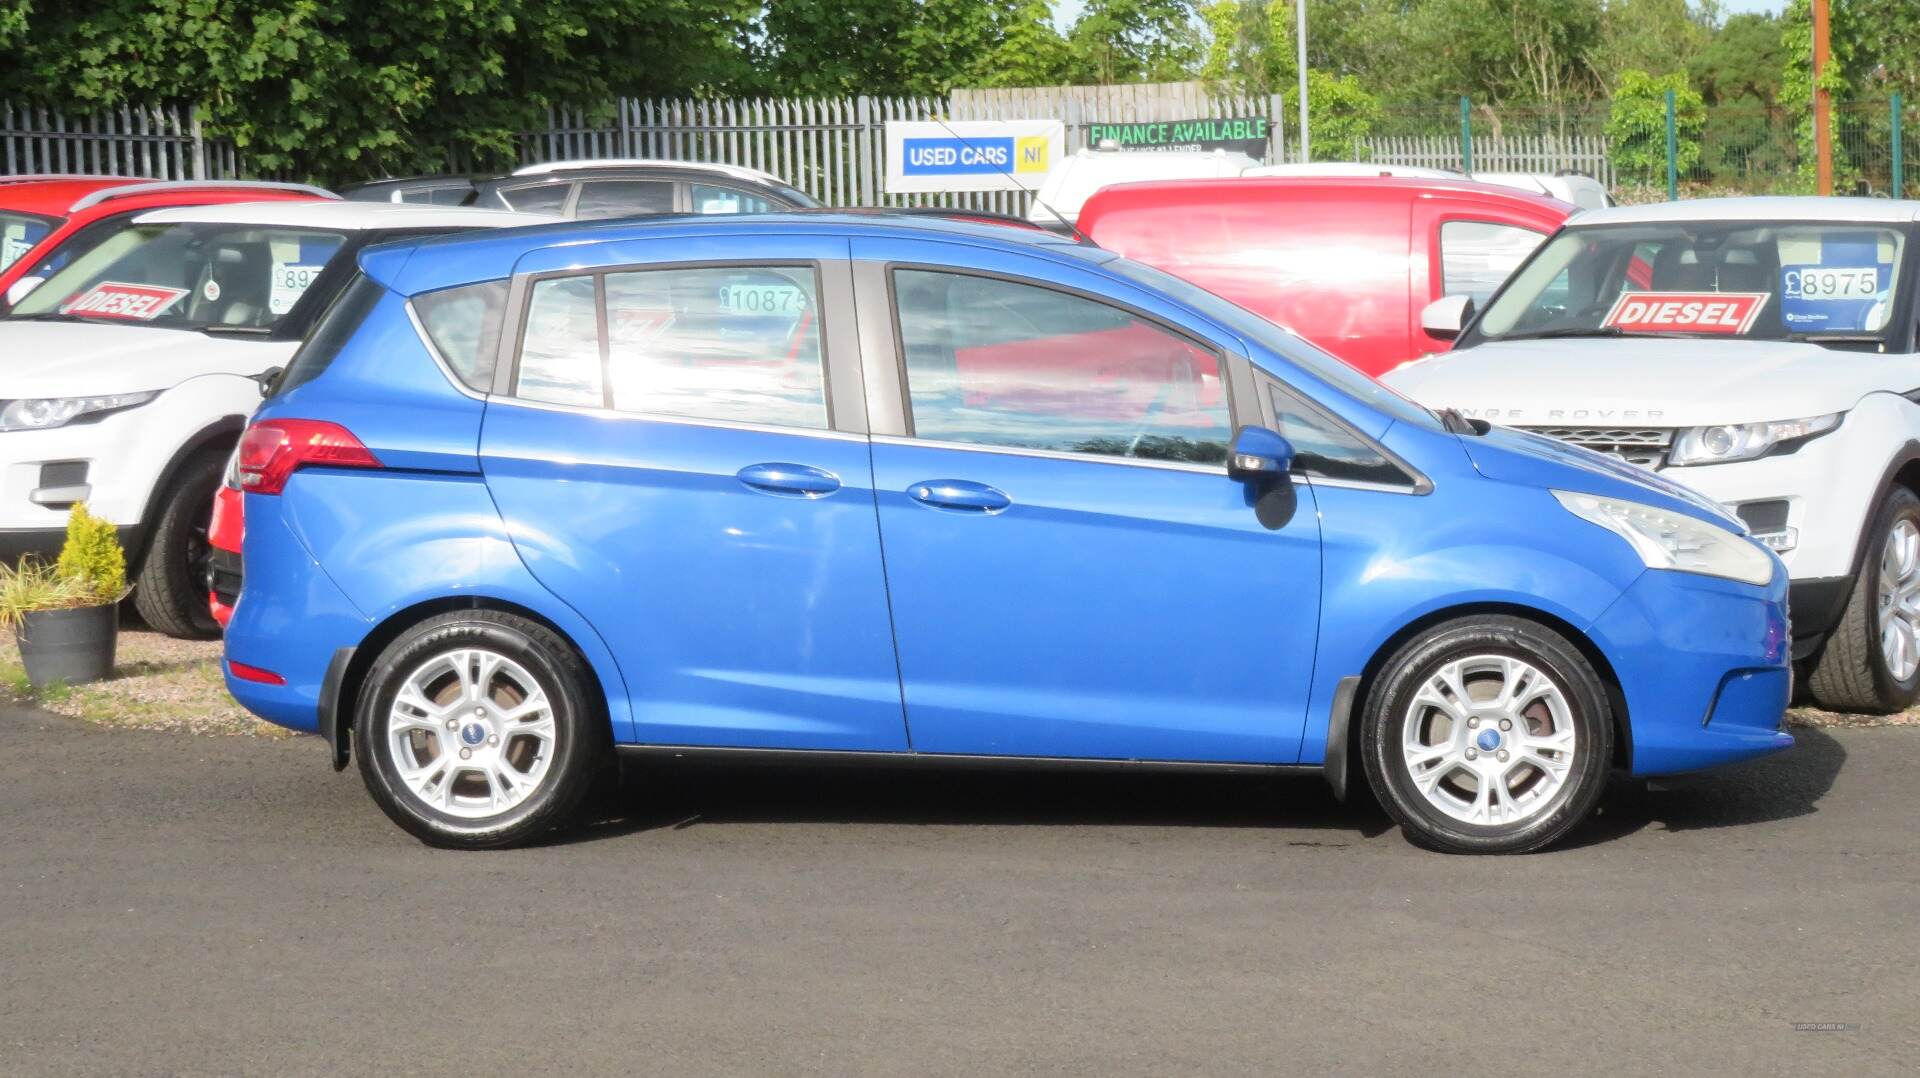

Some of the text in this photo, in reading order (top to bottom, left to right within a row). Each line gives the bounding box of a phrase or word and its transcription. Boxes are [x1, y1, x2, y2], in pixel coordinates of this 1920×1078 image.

[1091, 119, 1266, 145] FINANCE AVAILABLE
[910, 147, 1041, 166] USED CARS NI
[1785, 271, 1875, 295] £8975
[74, 291, 161, 318] DIESEL
[1617, 302, 1740, 326] DIESEL
[1549, 409, 1664, 418] ROVER
